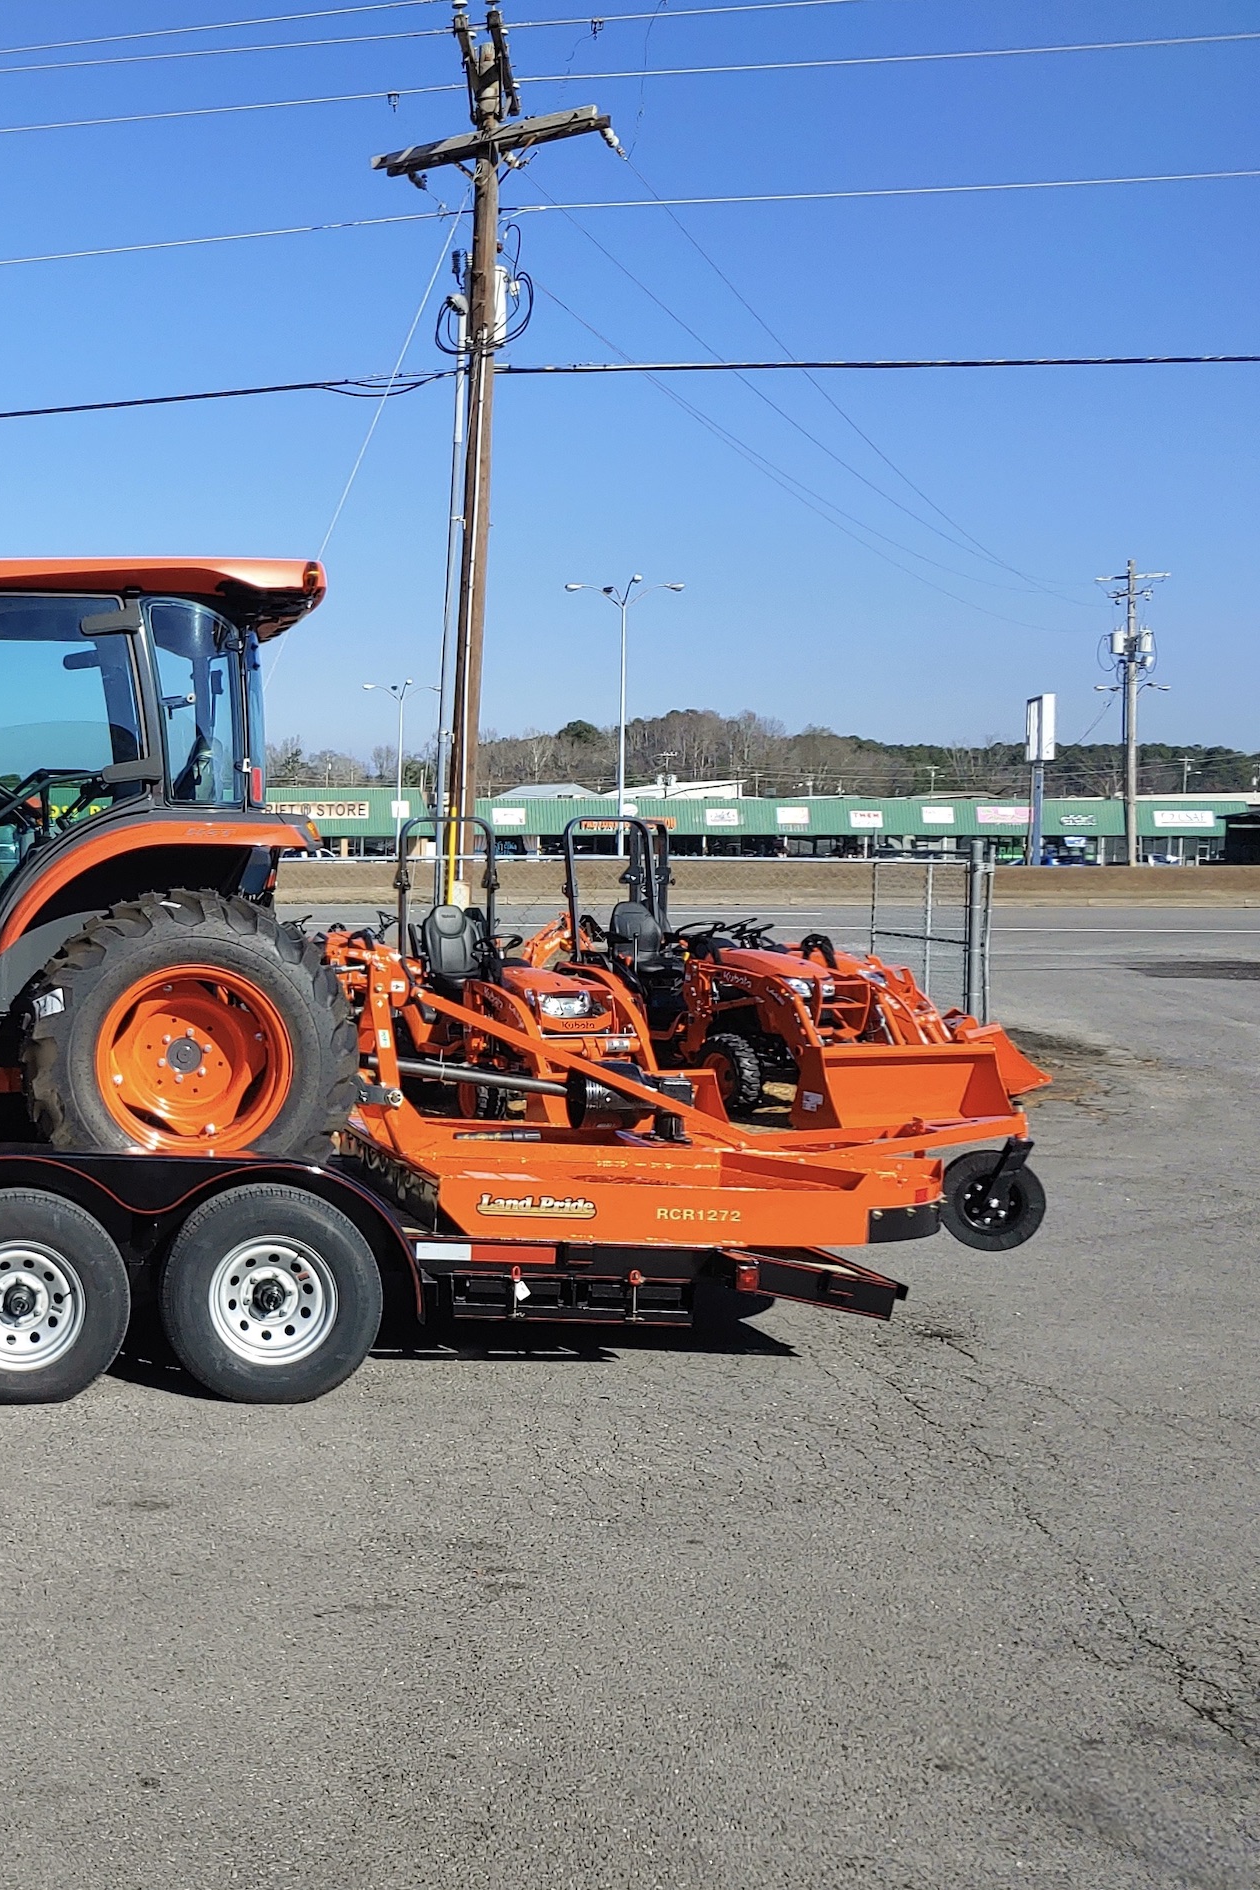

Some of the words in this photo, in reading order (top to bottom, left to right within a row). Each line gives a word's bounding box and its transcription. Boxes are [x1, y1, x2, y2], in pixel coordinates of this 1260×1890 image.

[265, 804, 296, 814] RIFT
[316, 803, 366, 816] STORE
[561, 1021, 595, 1029] Kubota
[480, 1193, 533, 1211] Land
[539, 1196, 596, 1213] Pride
[656, 1208, 741, 1222] RCR1272
